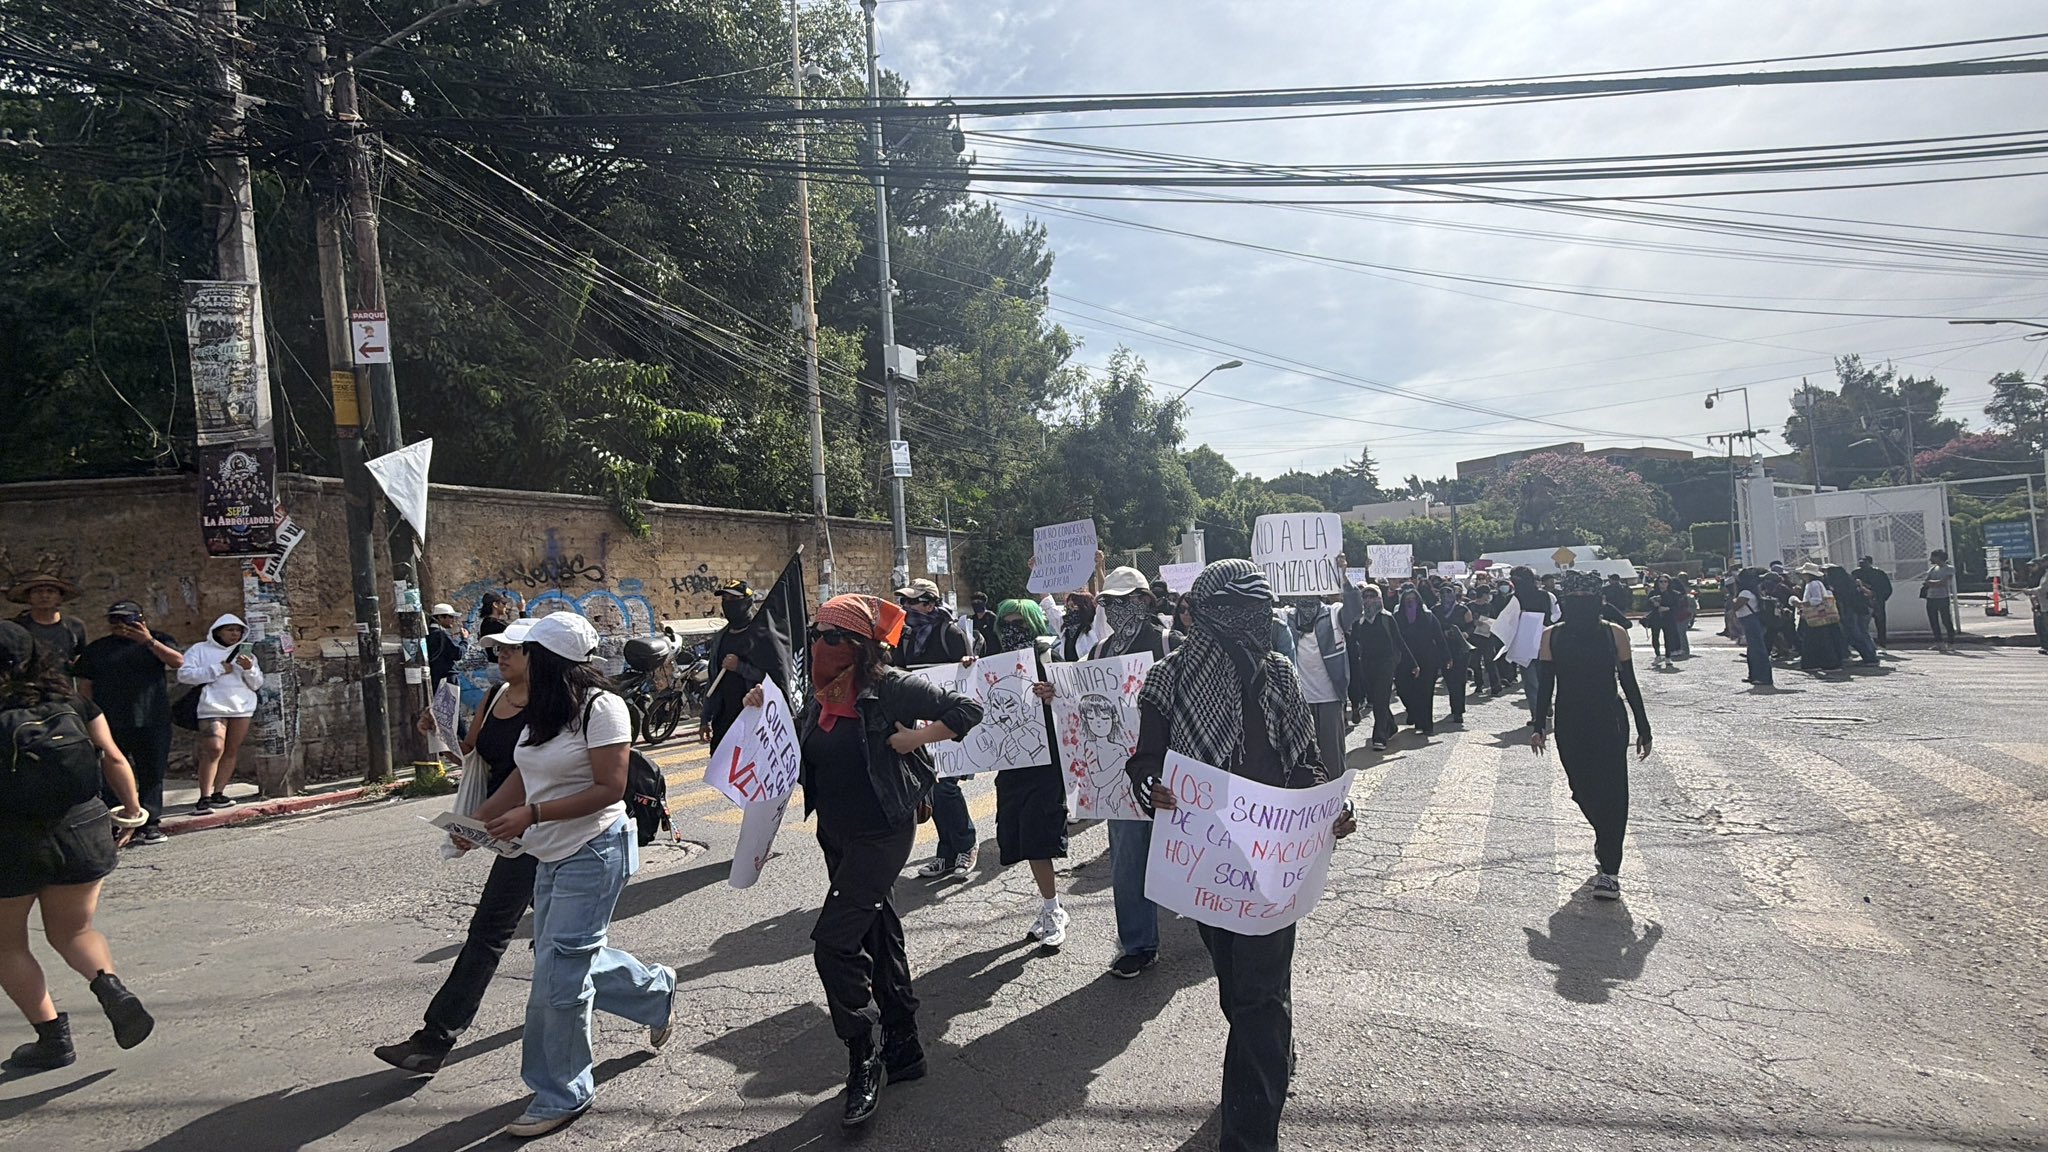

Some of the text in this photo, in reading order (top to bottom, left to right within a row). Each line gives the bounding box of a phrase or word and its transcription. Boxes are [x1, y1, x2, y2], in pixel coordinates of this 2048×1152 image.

[203, 516, 216, 527] LA
[218, 515, 274, 526] ARROLLADORA
[1058, 523, 1087, 538] CONOCER
[1255, 517, 1328, 556] NO A LA
[1038, 543, 1043, 554] A
[1059, 550, 1081, 562] AULAS
[1059, 564, 1074, 574] UNA
[1258, 554, 1341, 593] TIMIZACIÓN
[766, 700, 788, 749] QUE
[756, 726, 769, 750] NO
[767, 745, 779, 774] TE
[763, 773, 775, 799] LA
[1170, 764, 1213, 811] LOS
[1170, 806, 1328, 864] DE LA NACIÓN
[1165, 839, 1308, 891] HOY SON DE
[1194, 886, 1297, 919] TRISTEZA
